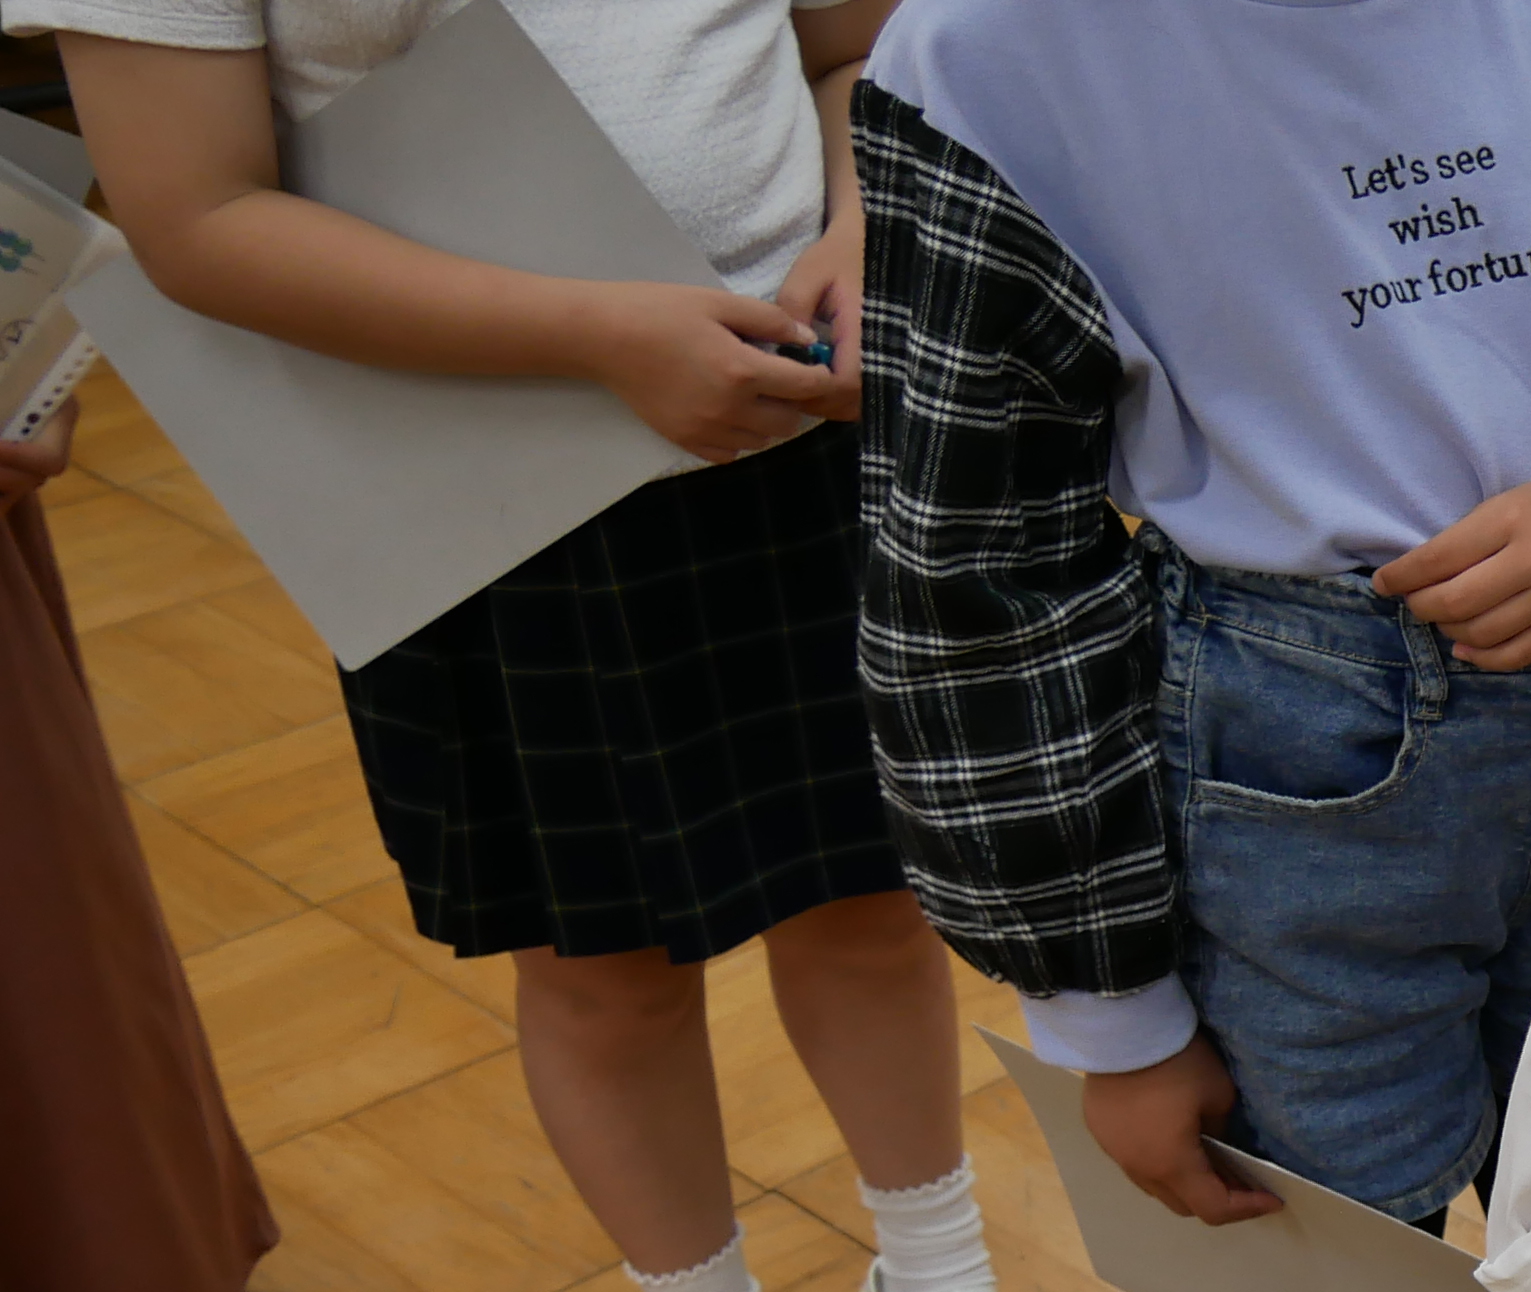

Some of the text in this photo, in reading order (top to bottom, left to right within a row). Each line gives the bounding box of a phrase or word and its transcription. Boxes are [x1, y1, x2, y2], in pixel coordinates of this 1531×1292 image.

[1341, 146, 1497, 200] Let's see
[1388, 197, 1484, 245] wish
[1342, 280, 1423, 329] your
